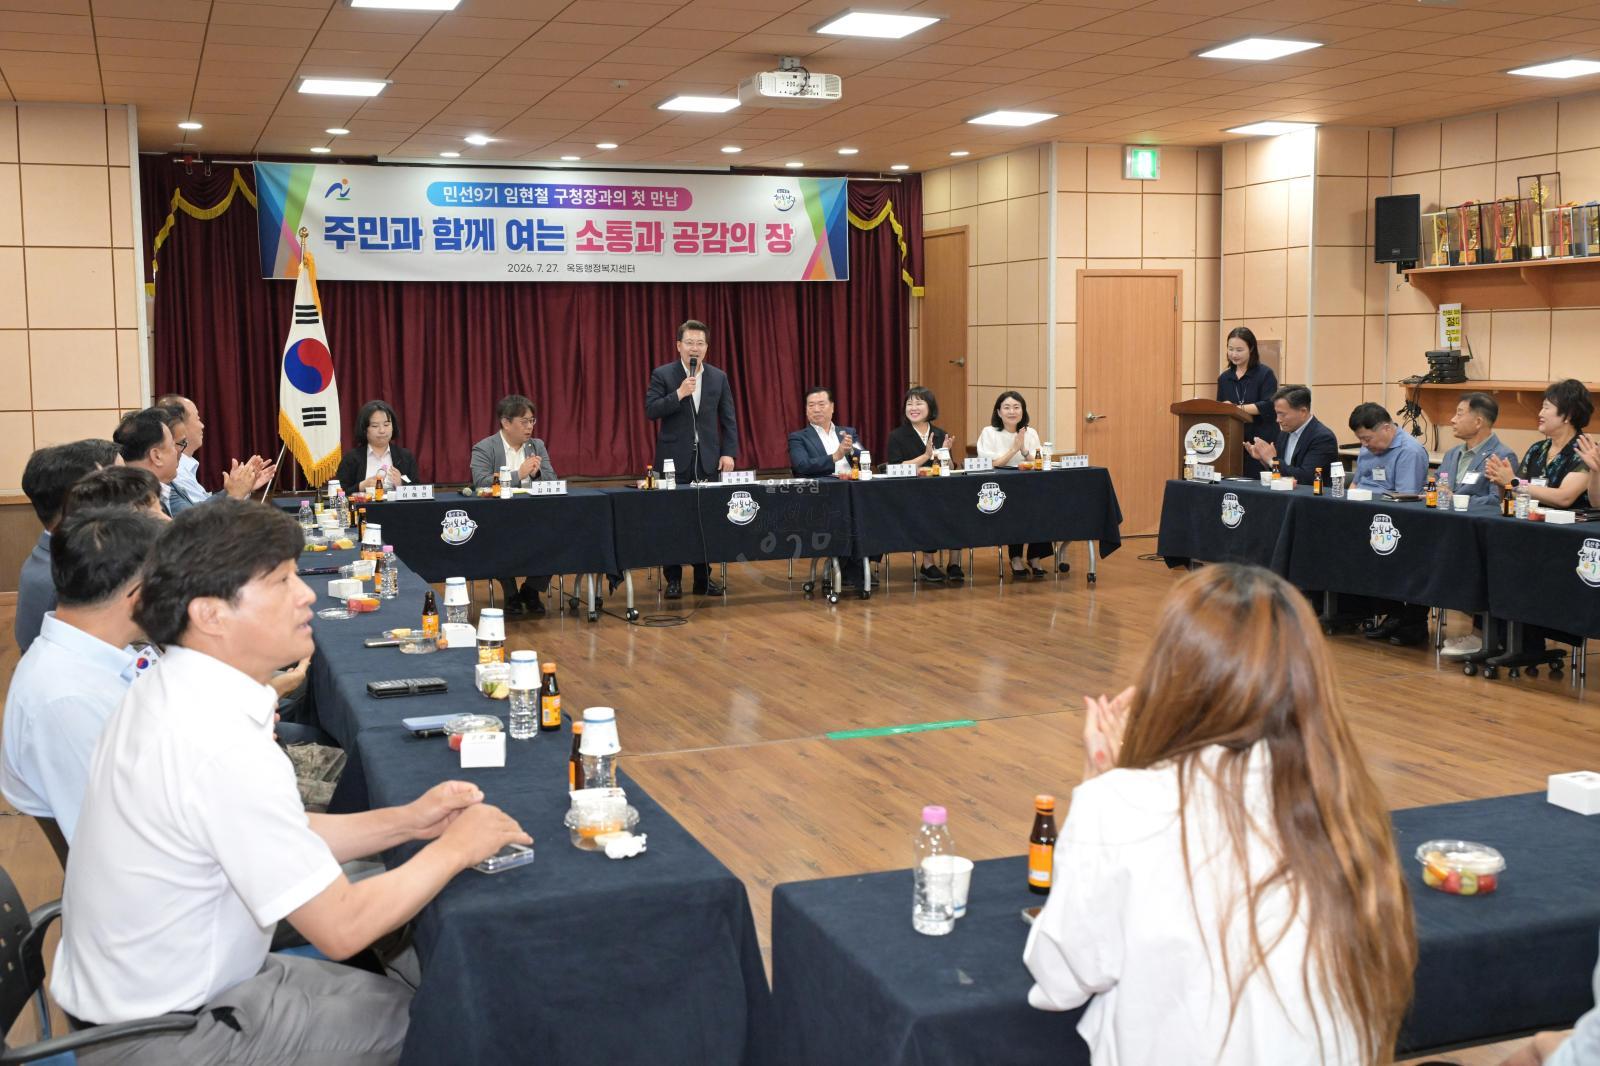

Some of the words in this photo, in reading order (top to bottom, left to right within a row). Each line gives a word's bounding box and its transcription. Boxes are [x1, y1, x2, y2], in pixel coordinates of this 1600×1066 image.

[443, 185, 499, 204] 민선9기
[504, 186, 549, 204] 임현철
[554, 188, 626, 206] 구청장과의
[632, 190, 645, 207] 첫
[651, 191, 679, 207] 만남
[323, 215, 424, 251] 주민과
[432, 216, 496, 252] 함께
[505, 218, 565, 252] 여는
[575, 220, 665, 253] 소통과
[672, 221, 757, 254] 공감의
[765, 223, 794, 254] 장
[507, 263, 534, 273] 2026.
[536, 263, 543, 273] 7.
[546, 263, 559, 273] 27.
[566, 263, 636, 273] 옥동행정복지센터
